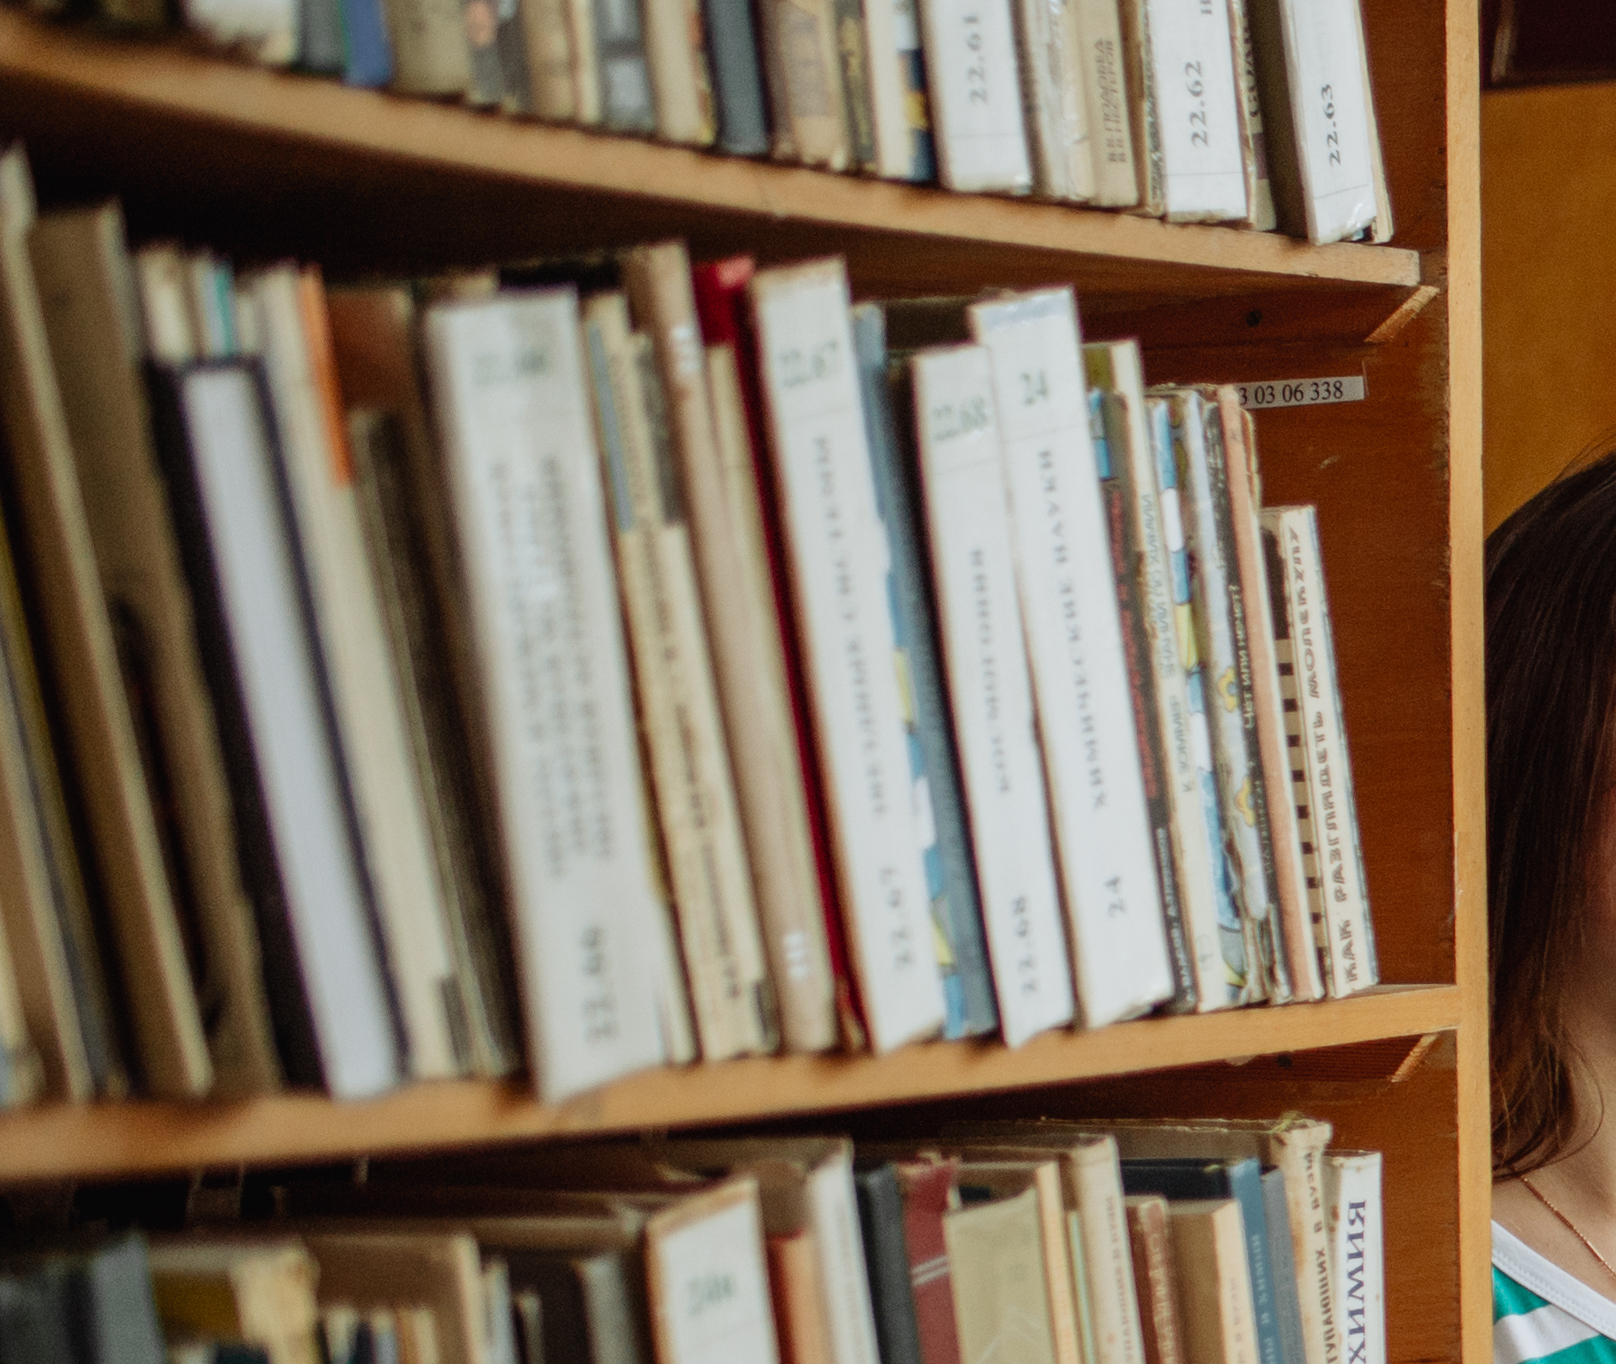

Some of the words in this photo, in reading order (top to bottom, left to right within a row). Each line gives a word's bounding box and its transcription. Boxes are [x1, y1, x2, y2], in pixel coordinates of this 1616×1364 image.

[958, 13, 991, 105] 22.61
[1183, 60, 1209, 147] 22.62
[1318, 83, 1341, 167] 22.63
[1254, 386, 1276, 405] 03
[1282, 383, 1304, 403] 06
[1310, 380, 1344, 401] 338
[1035, 448, 1070, 566] НАУКИ
[1056, 579, 1110, 810] ХИМИЧЕСКИЕ
[1309, 710, 1347, 903] РАЗГЛЯДЕТЬ
[1103, 875, 1127, 917] 24
[1336, 918, 1358, 984] КАК
